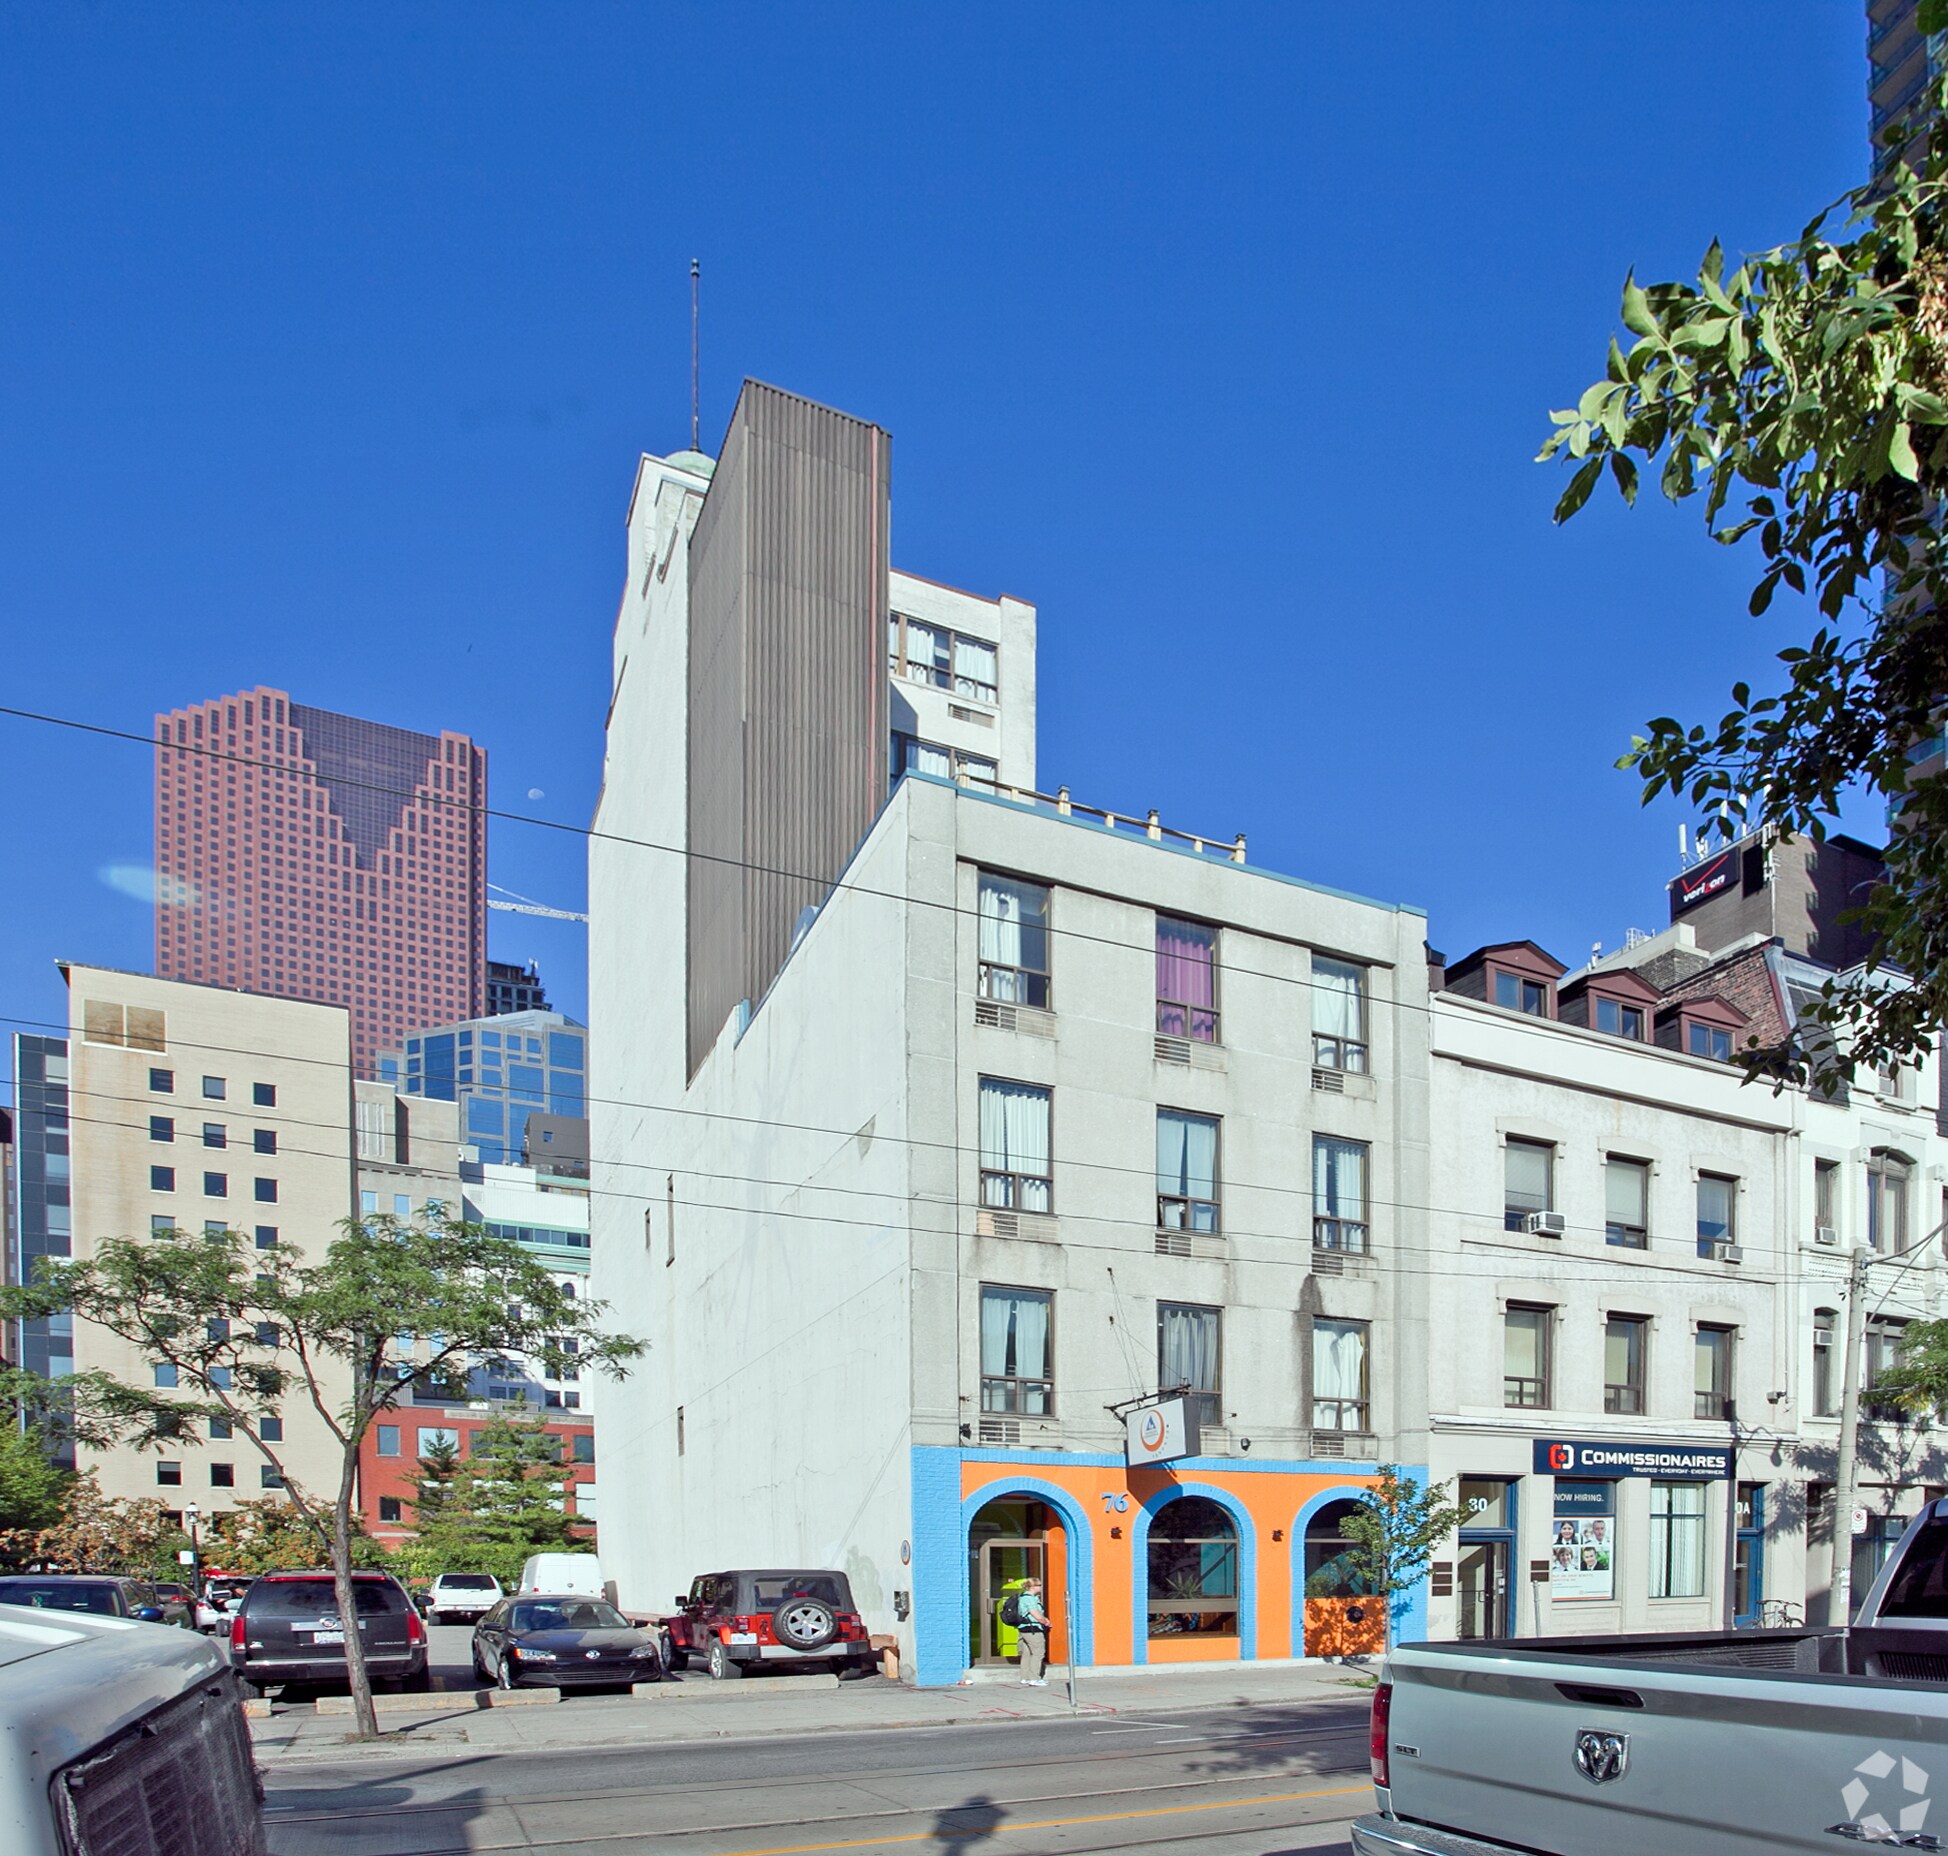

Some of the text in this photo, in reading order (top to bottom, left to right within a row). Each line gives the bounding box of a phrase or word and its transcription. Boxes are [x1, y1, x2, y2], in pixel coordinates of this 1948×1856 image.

[1683, 874, 1726, 903] verizon
[1581, 1449, 1726, 1468] COMMISSIONAIRES
[1101, 1492, 1130, 1513] 76
[1468, 1497, 1488, 1512] 30
[1553, 1493, 1572, 1502] NOW
